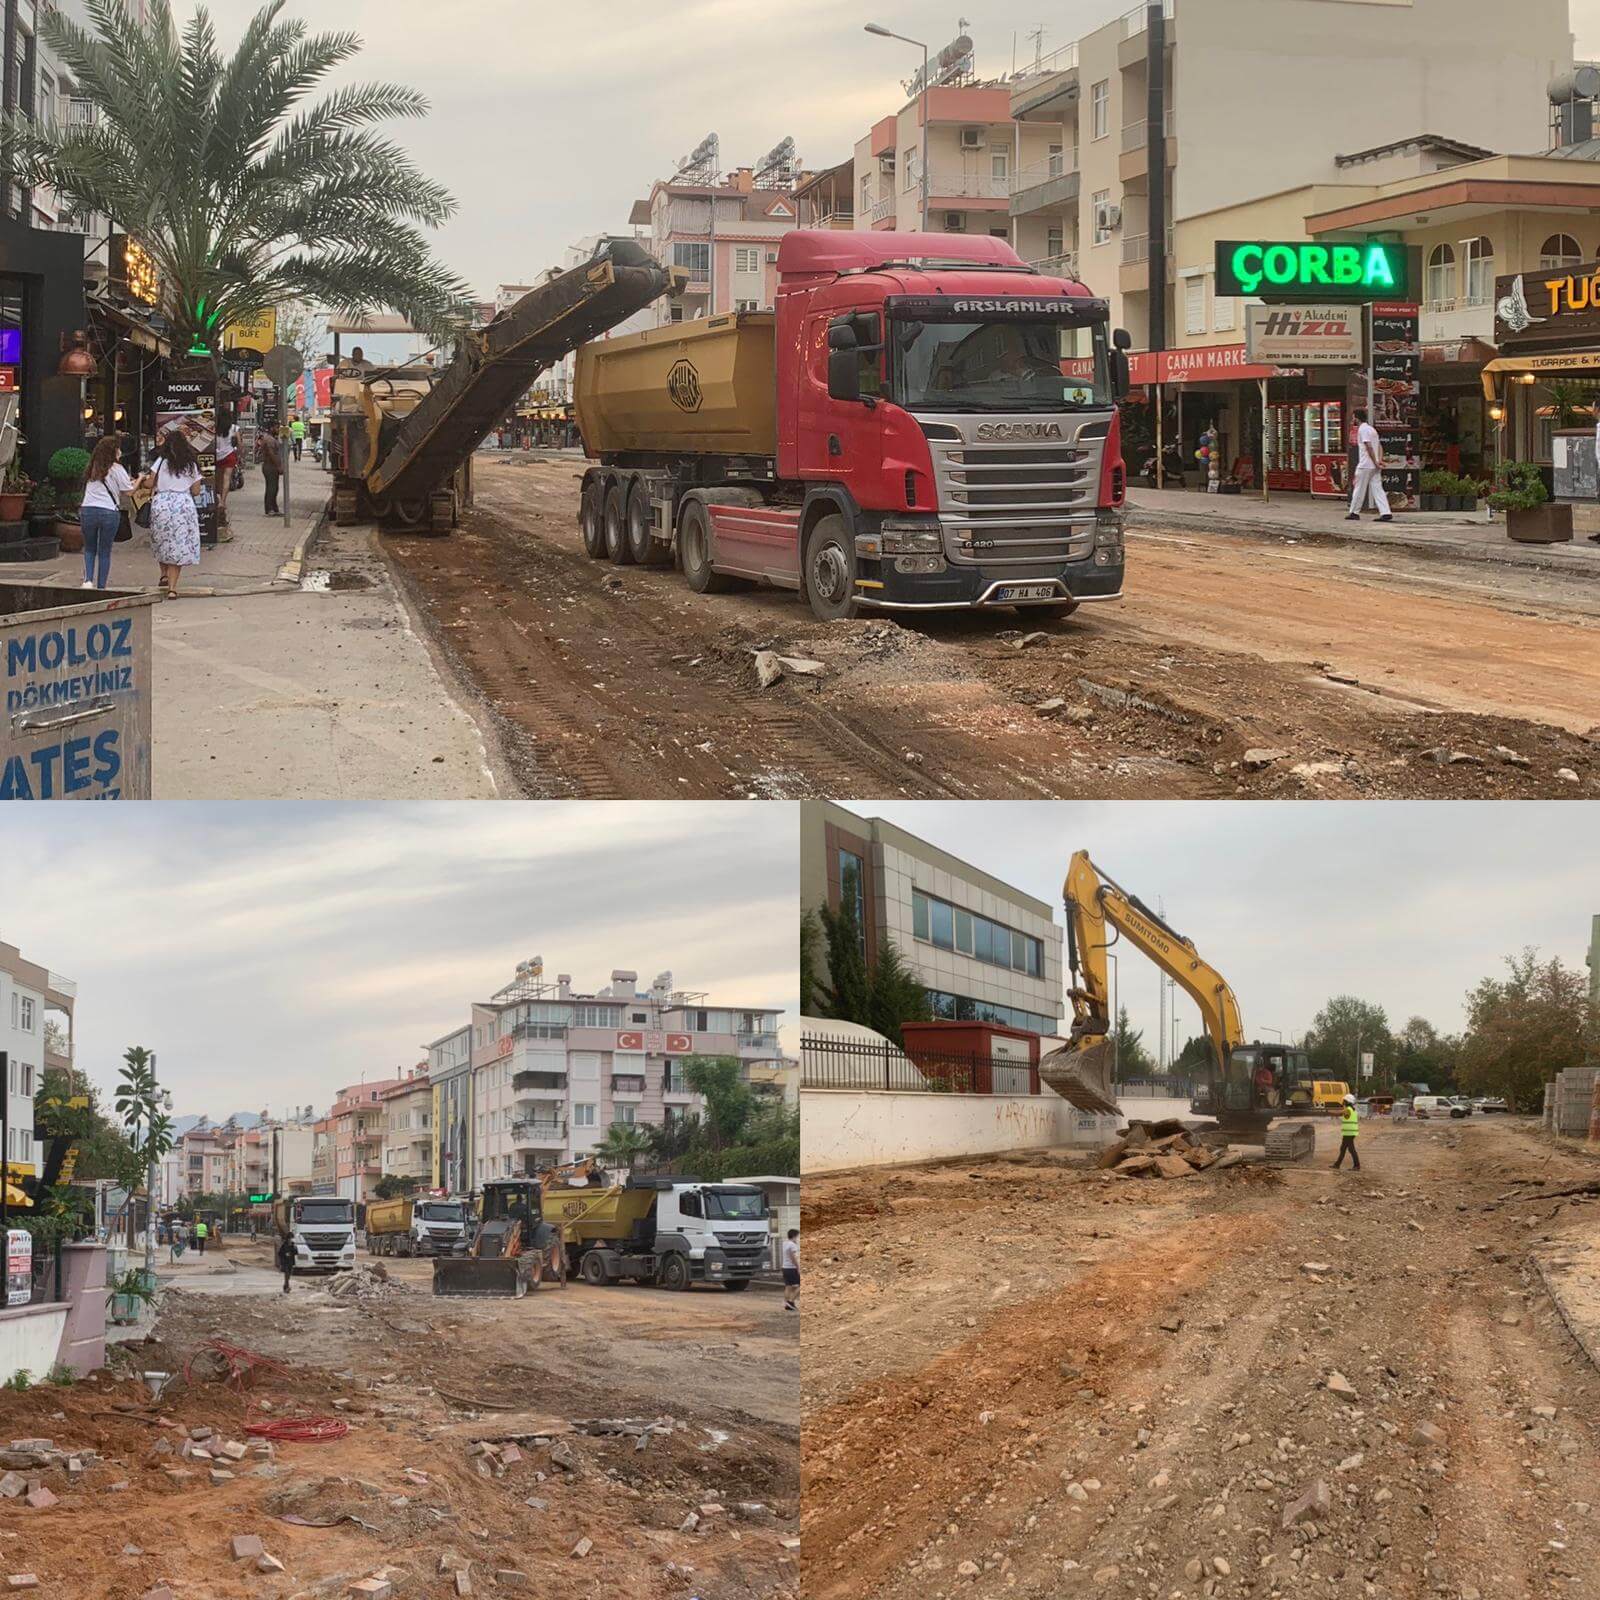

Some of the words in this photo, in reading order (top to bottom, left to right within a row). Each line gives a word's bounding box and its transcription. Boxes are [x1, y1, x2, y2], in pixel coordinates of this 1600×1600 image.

[1231, 244, 1395, 293] ÇORBA
[953, 300, 1075, 314] ARSLANLAR
[1167, 352, 1203, 370] CANAN
[1207, 349, 1247, 368] MARKE
[168, 384, 201, 392] MOKKA
[977, 422, 1063, 440] SCANIA
[7, 618, 133, 677] MOLOZ
[7, 664, 133, 713] DÖKMEYİNİZ
[0, 729, 121, 800] ATEŞ
[1124, 913, 1170, 954] SUMITOMO
